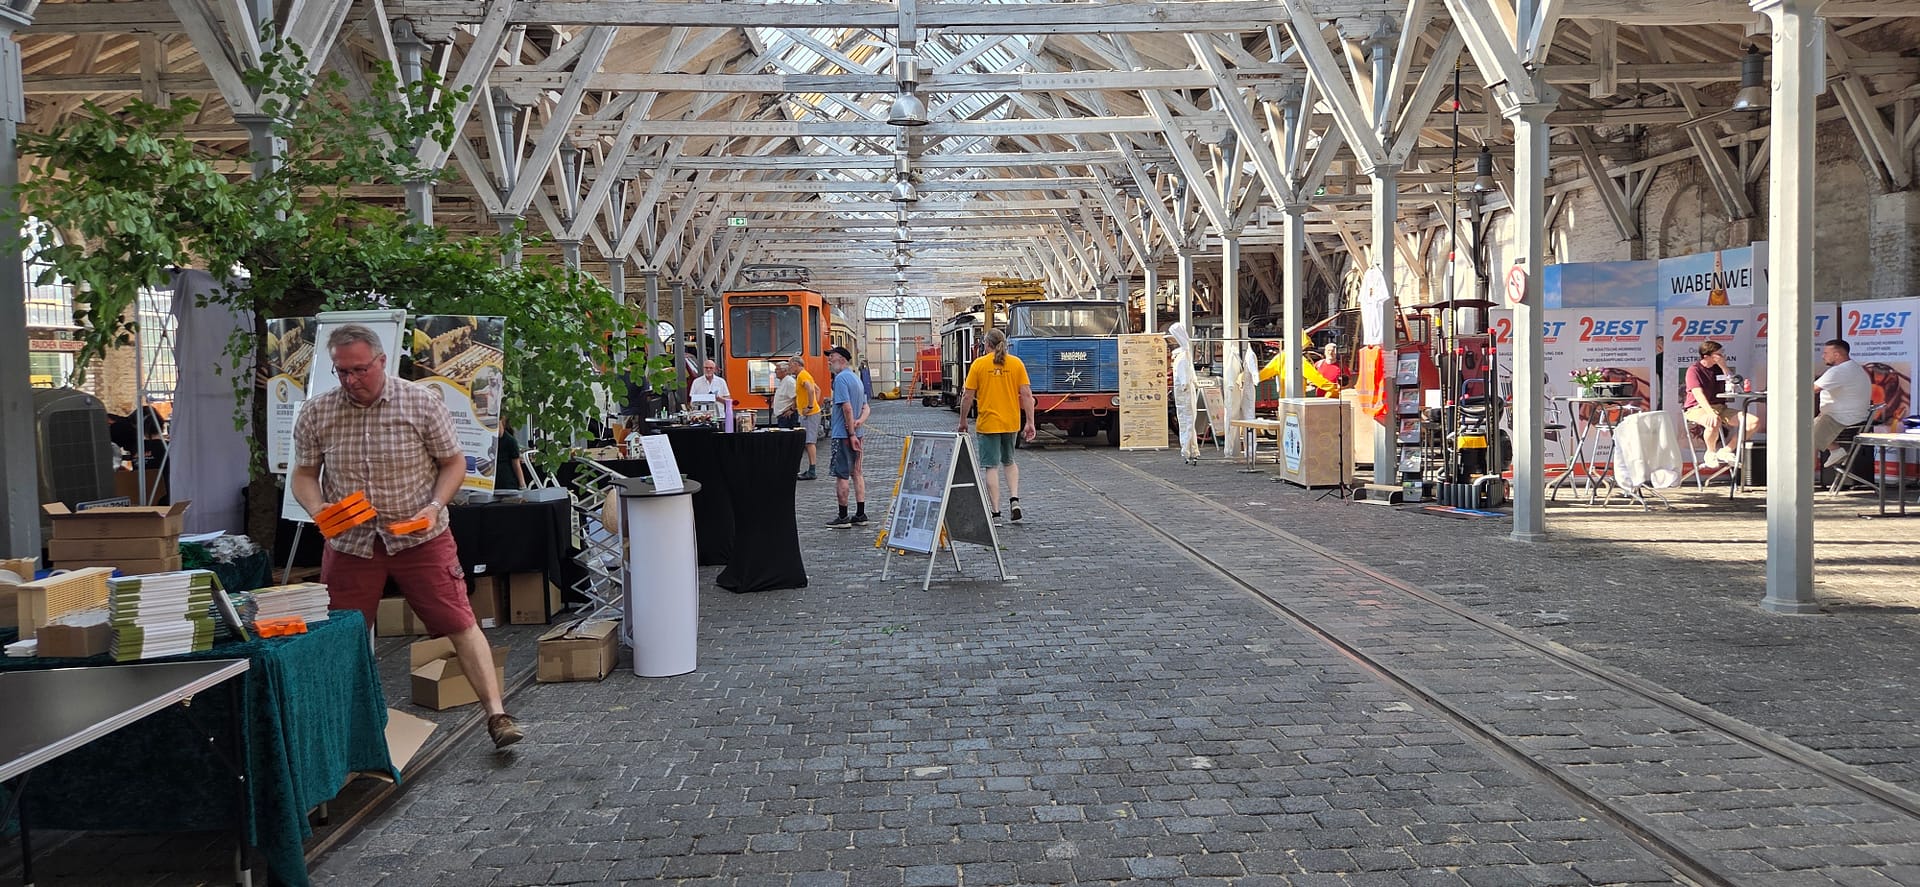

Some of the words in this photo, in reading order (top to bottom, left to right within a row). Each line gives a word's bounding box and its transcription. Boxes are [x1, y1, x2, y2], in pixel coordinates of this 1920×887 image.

[1579, 317, 1648, 342] 2BEST
[1672, 316, 1744, 342] 2BEST
[1848, 310, 1912, 336] 2BEST
